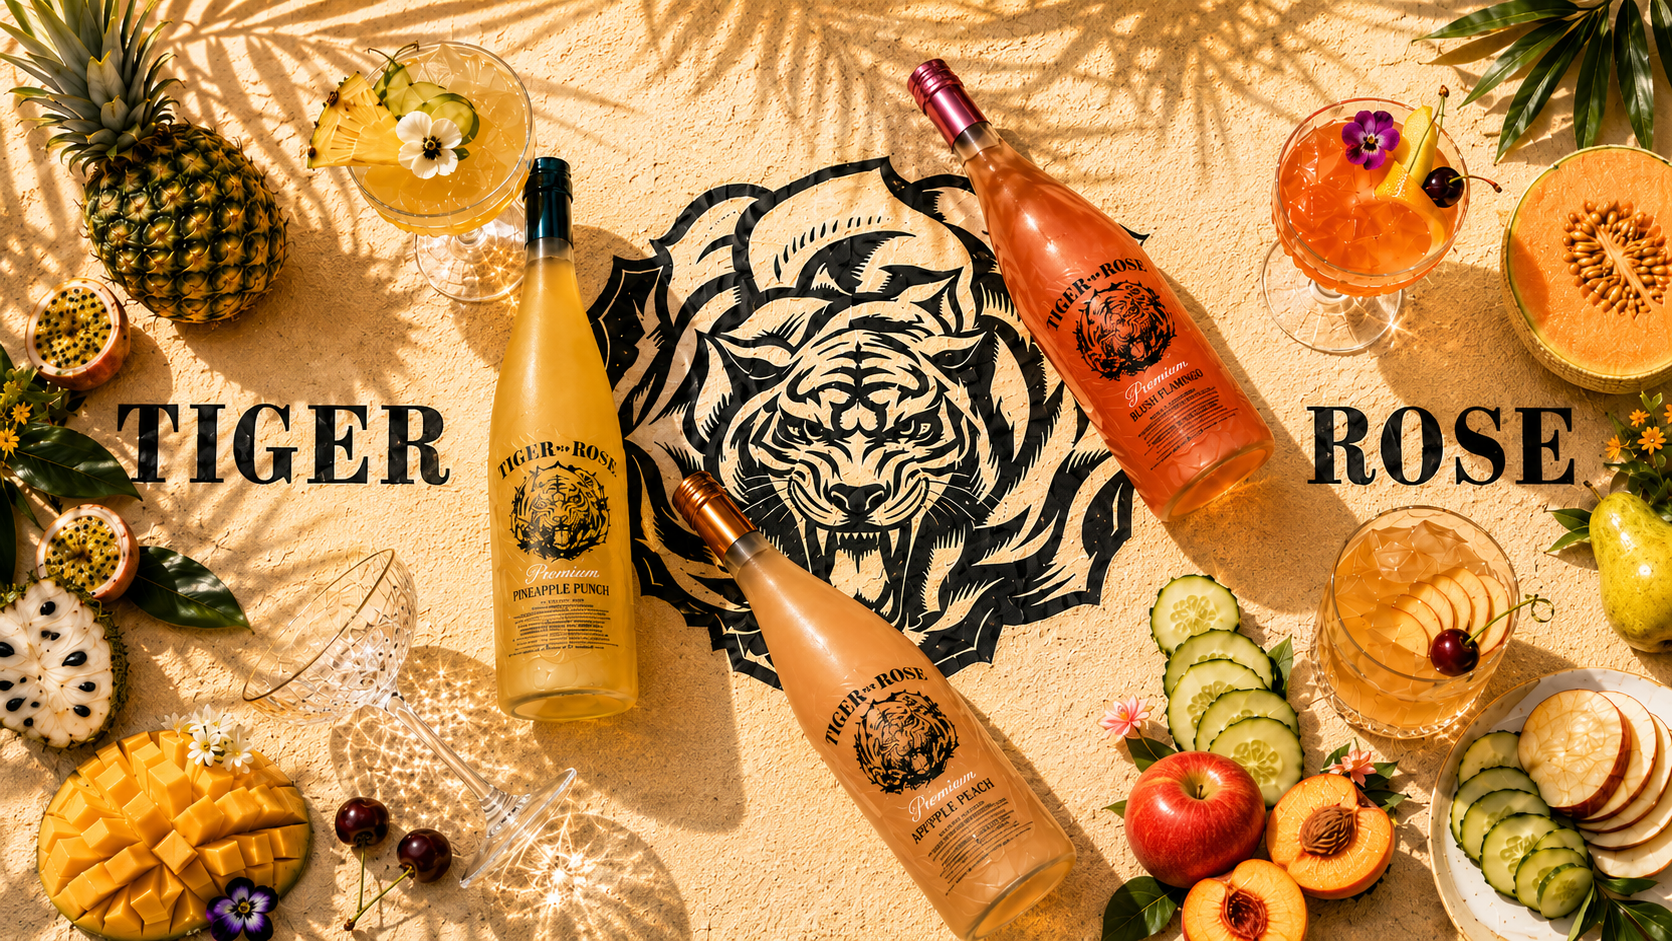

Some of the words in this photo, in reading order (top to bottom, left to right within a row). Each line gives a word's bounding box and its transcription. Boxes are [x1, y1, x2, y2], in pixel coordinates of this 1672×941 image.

[1046, 278, 1092, 331] TIGER
[1099, 258, 1148, 279] ROSE
[1124, 360, 1189, 408] Premium
[1129, 394, 1160, 422] BLUSH
[117, 403, 450, 485] TIGER
[1306, 406, 1575, 486] ROSE
[497, 441, 556, 480] TIGER
[512, 583, 571, 602] PINEAPPLE
[573, 583, 610, 596] PUNCH
[525, 563, 600, 585] Premium
[825, 689, 867, 746] TIGER
[874, 666, 928, 690] ROSE
[956, 777, 995, 805] PEACH
